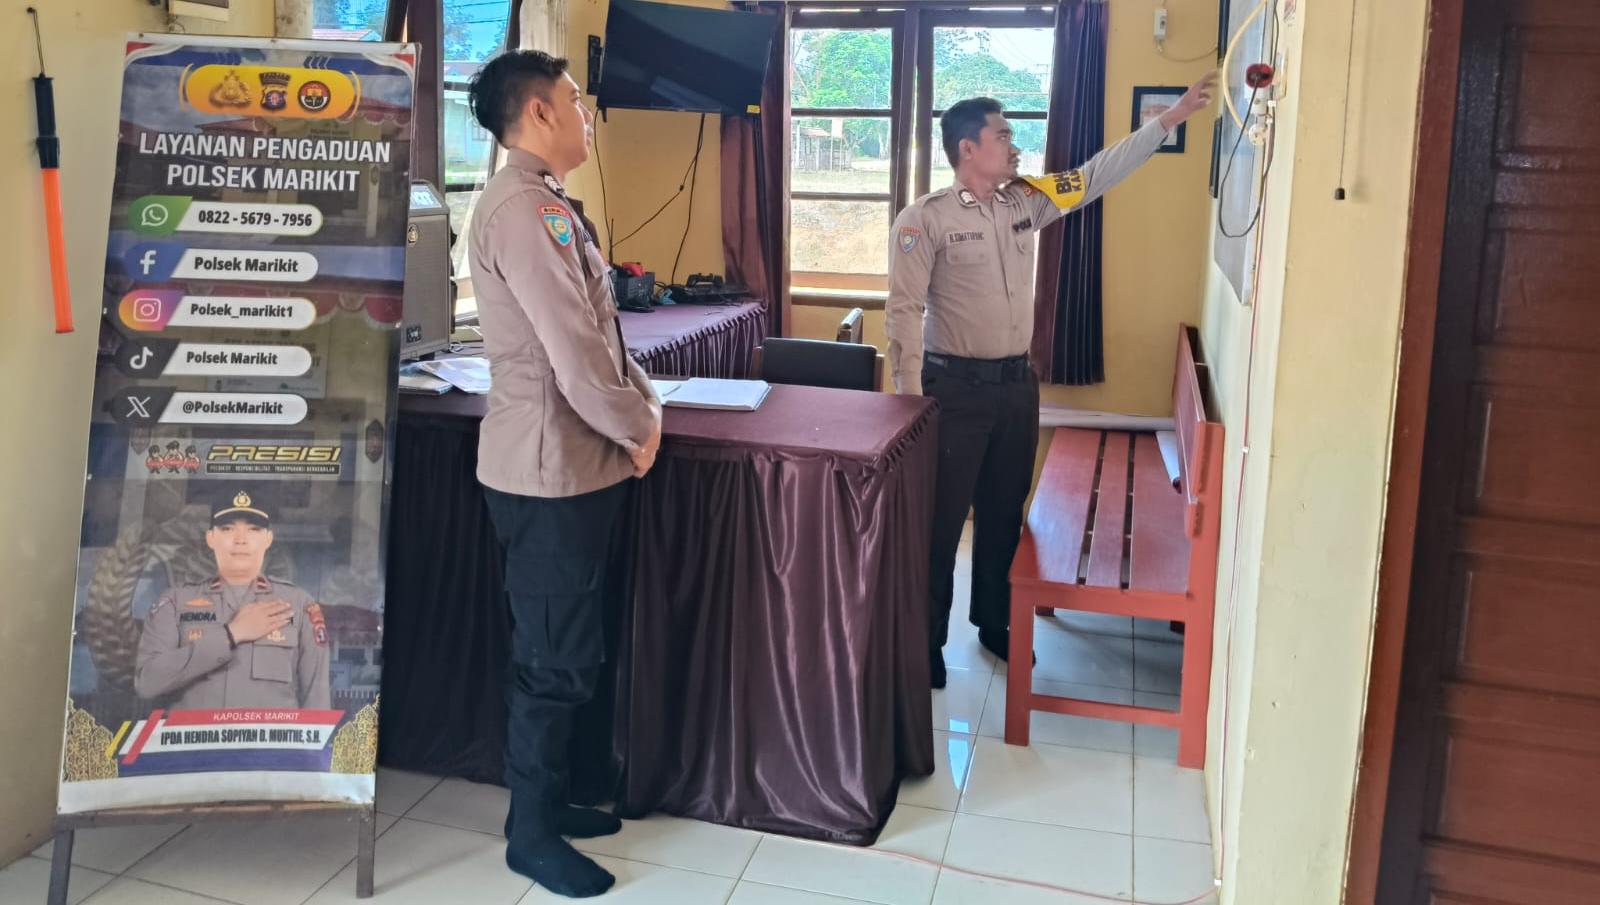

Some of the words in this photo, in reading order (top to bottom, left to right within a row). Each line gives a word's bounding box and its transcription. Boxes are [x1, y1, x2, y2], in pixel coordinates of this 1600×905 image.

[139, 132, 246, 158] LAYANAN
[252, 137, 391, 163] PENGADUAN
[166, 163, 257, 189] POLSEK
[263, 167, 361, 192] MARIKIT
[198, 210, 230, 224] 0822
[240, 211, 272, 225] 5679
[282, 213, 313, 227] 7956
[194, 256, 242, 272] Polsek
[245, 258, 299, 273] Marikit
[190, 302, 293, 319] Polsek_marikit1
[186, 351, 228, 364] Polsek
[230, 352, 278, 365] Marikit
[182, 400, 283, 415] @PolsekMarikit
[207, 444, 341, 462] PRESISI
[180, 611, 217, 622] HENDRA
[213, 712, 262, 721] KAPOLSEK
[264, 712, 300, 721] MARIKIT
[161, 731, 182, 746] IPDA
[184, 729, 219, 744] HENDRA
[221, 728, 257, 743] SOPIYAN
[259, 728, 267, 742] D.
[269, 728, 305, 744] MUNTHE,
[306, 729, 321, 743] S.H.
